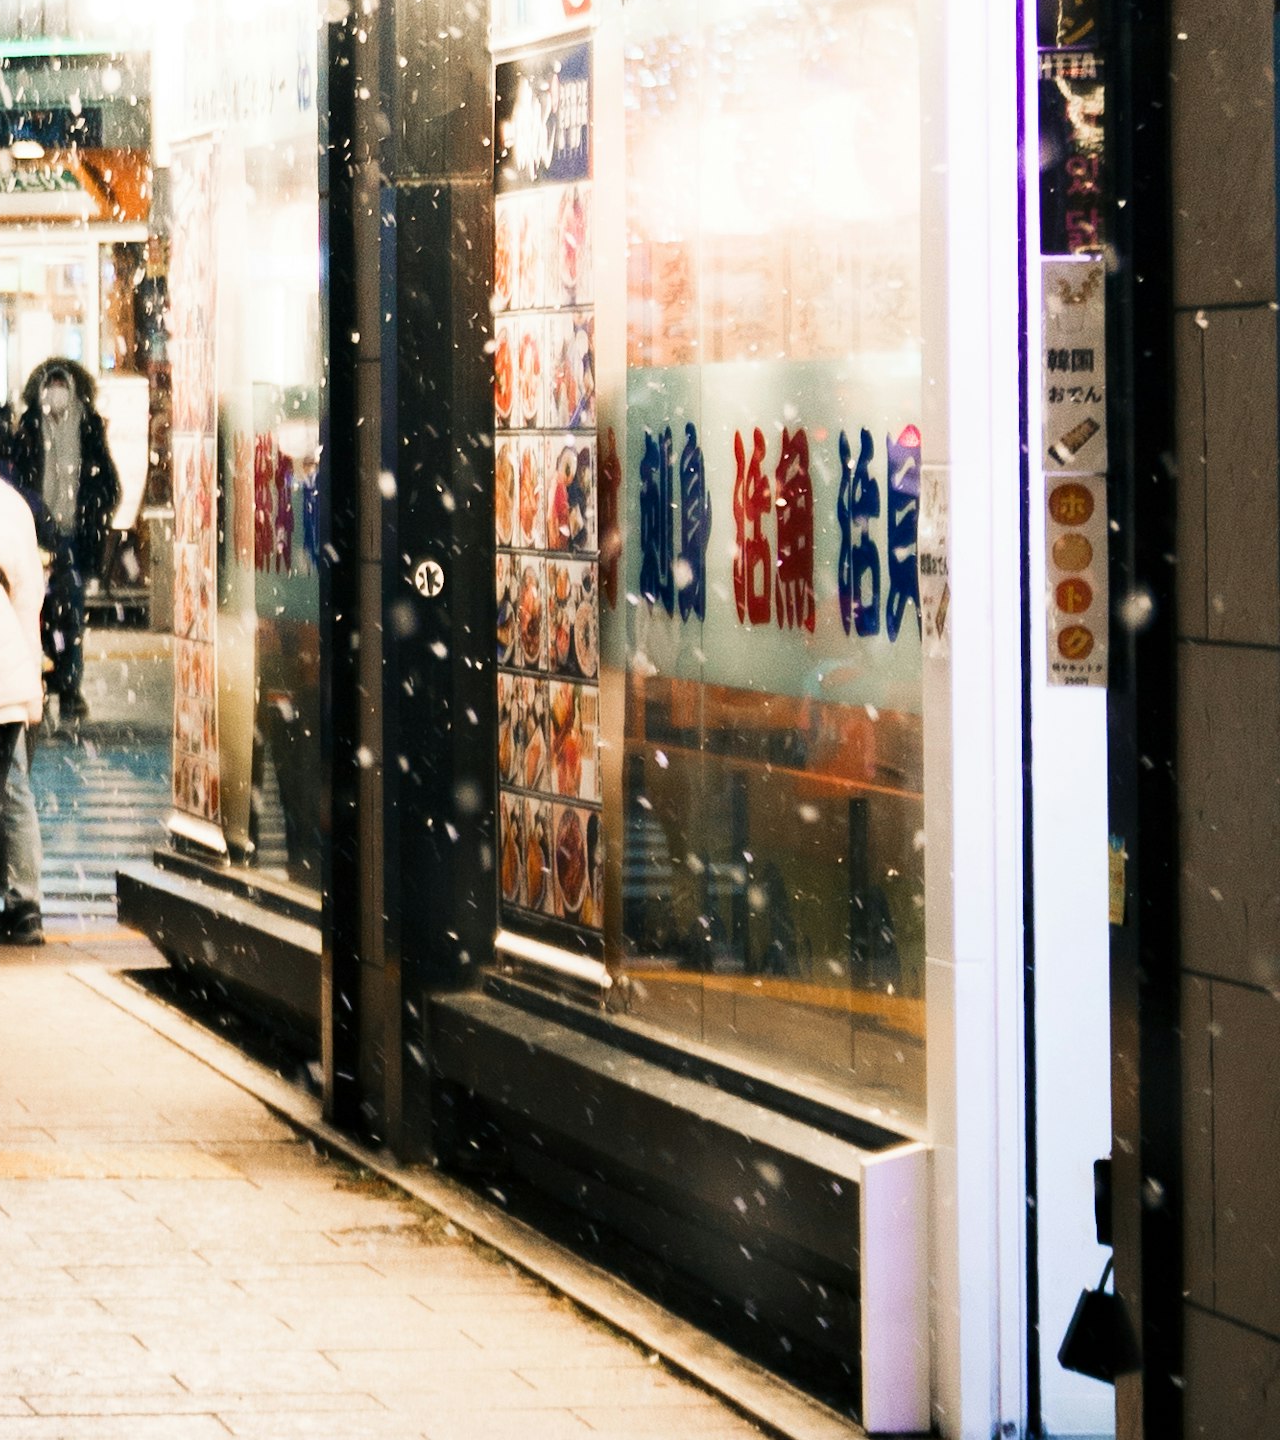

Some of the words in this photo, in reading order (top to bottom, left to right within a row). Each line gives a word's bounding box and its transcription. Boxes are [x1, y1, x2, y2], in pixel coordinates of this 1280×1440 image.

[1047, 347, 1095, 373] 韓国
[1048, 385, 1102, 404] おでん
[733, 426, 817, 635] 活魚
